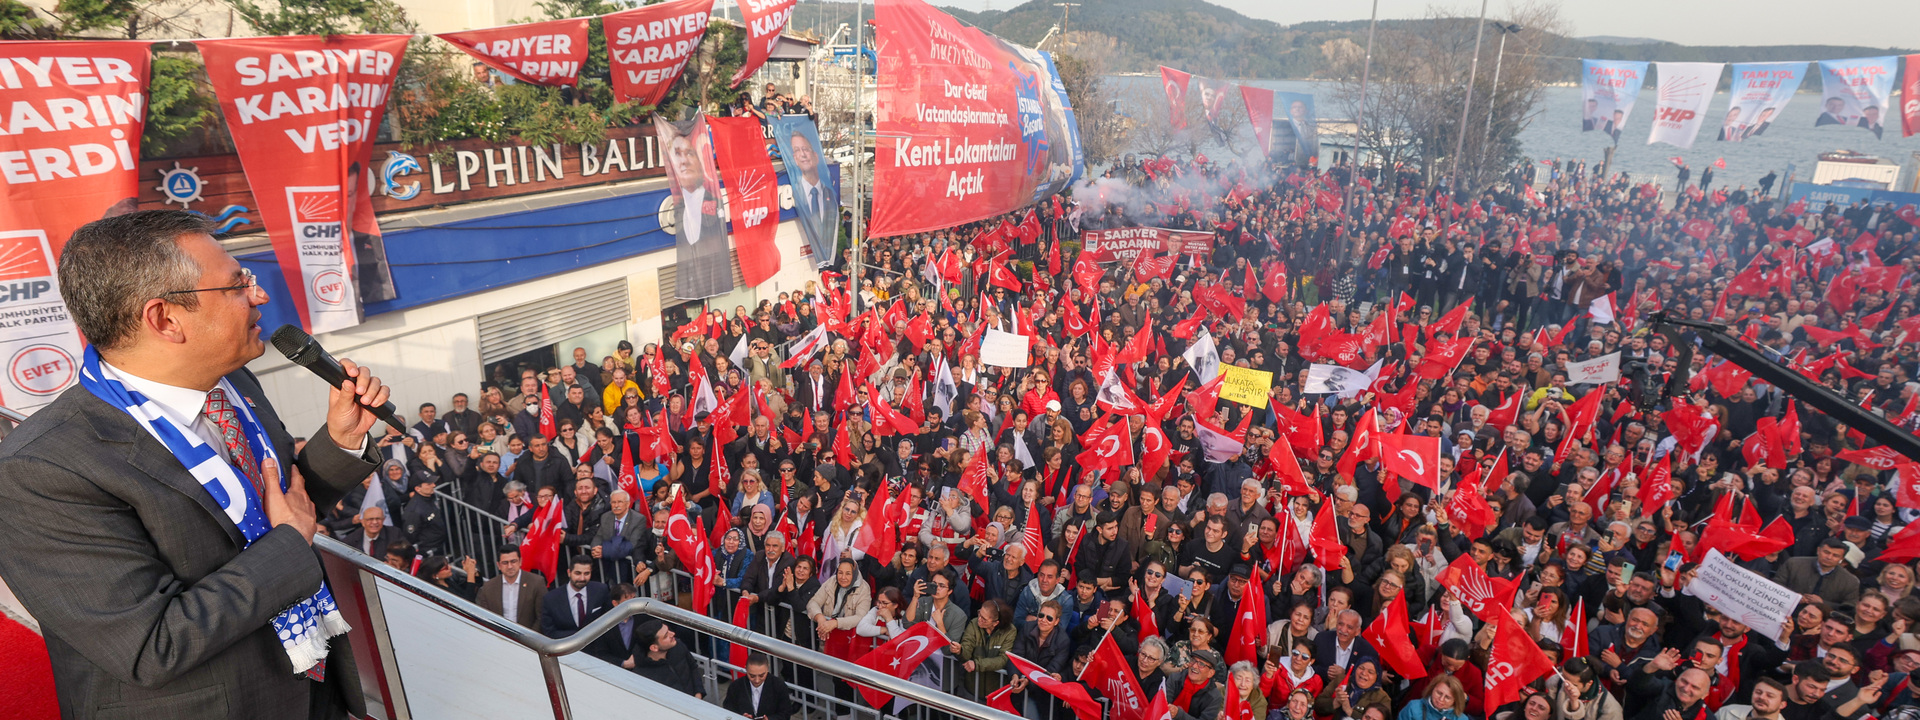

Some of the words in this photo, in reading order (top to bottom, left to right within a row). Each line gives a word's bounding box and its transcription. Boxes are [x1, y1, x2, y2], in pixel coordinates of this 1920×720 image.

[616, 11, 707, 45] SARIYER
[235, 49, 394, 86] SARIYER
[1589, 67, 1614, 77] TAM
[1617, 69, 1639, 80] YOL
[1742, 70, 1768, 80] TAM
[1772, 70, 1795, 80] YOL
[1828, 66, 1860, 77] TAM
[1861, 65, 1888, 76] YOL
[944, 79, 963, 98] Dar
[1747, 78, 1781, 89] İLERİ
[234, 82, 389, 125] KARARINI
[915, 103, 995, 127] Vatandaşlarımız
[895, 138, 942, 167] Kent
[945, 137, 1017, 165] Lokantaları
[946, 168, 984, 201] Açtık
[742, 206, 768, 229] CHP
[303, 225, 341, 238] CHP
[1104, 229, 1158, 240] SARIYER
[1101, 239, 1160, 251] KARARINI
[25, 312, 68, 325] PARTİSİ
[22, 360, 61, 381] EVET
[1708, 563, 1724, 577] ALTI
[1725, 573, 1752, 592] OKUN
[1752, 587, 1786, 609] İZİNDE
[1755, 578, 1791, 600] YOLUNDA
[1747, 596, 1781, 616] YOLLARA
